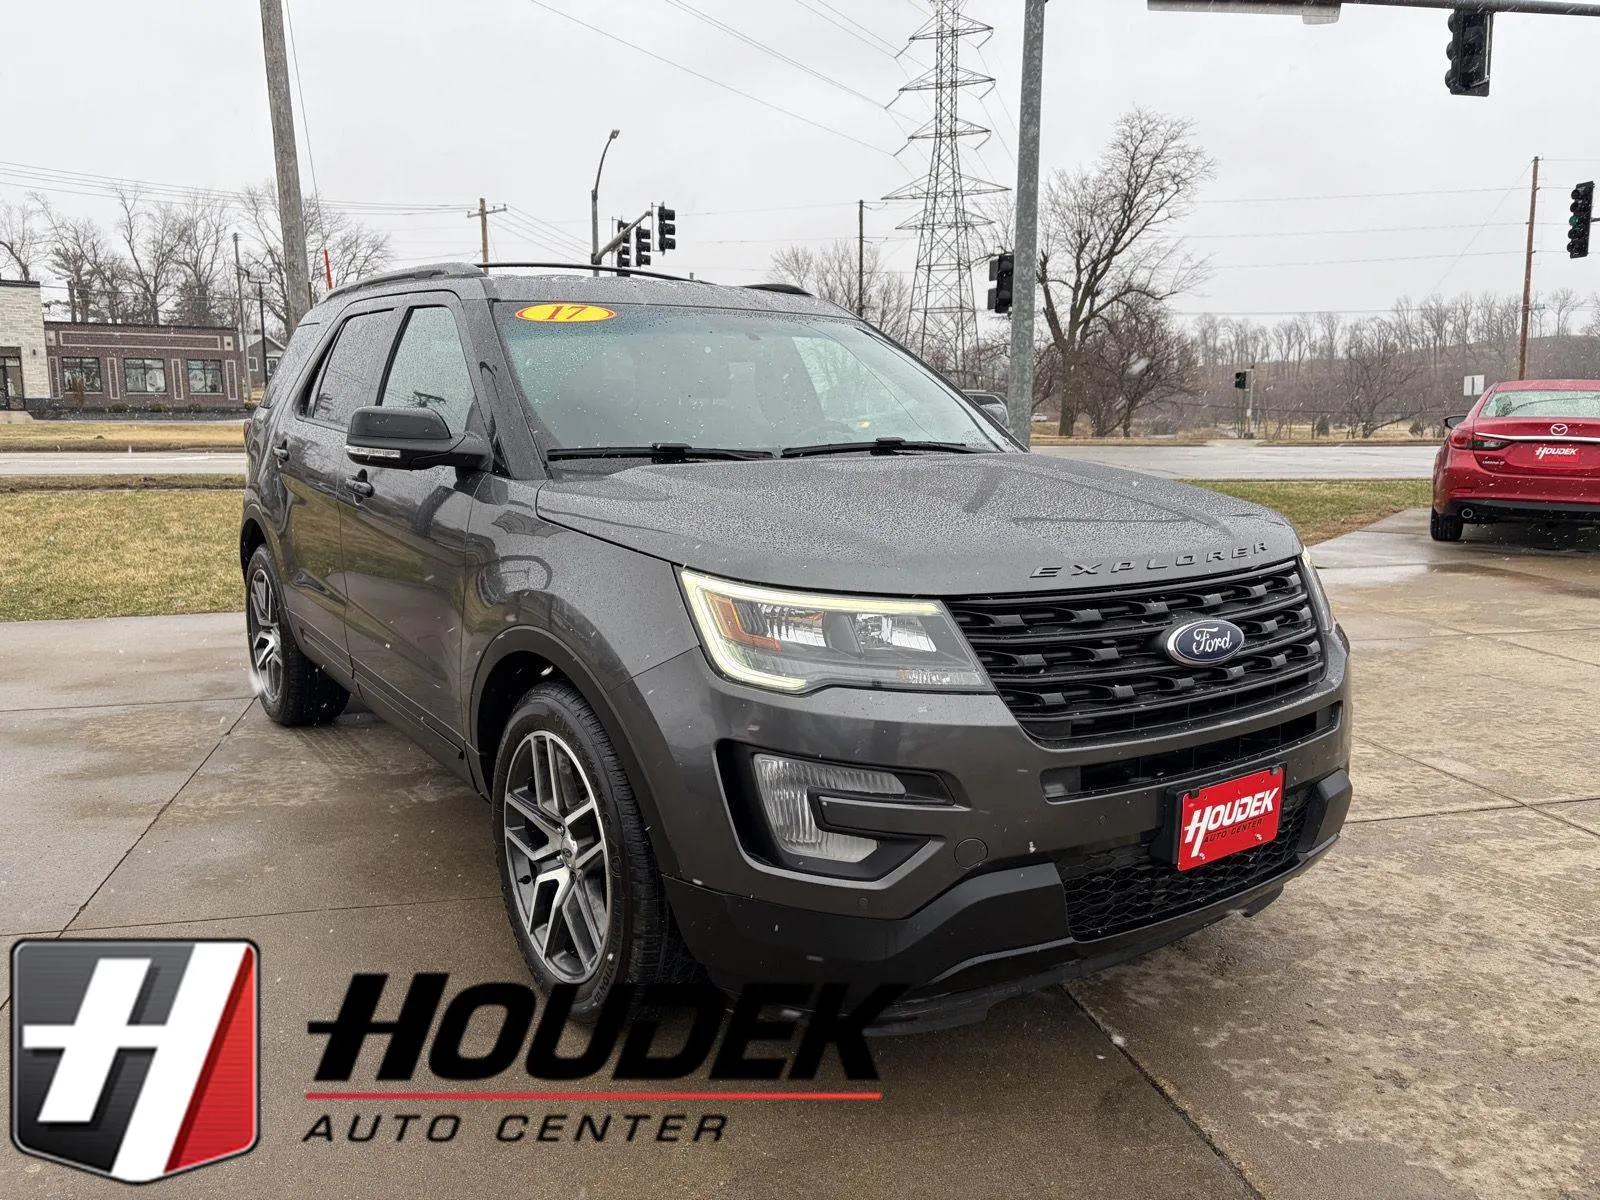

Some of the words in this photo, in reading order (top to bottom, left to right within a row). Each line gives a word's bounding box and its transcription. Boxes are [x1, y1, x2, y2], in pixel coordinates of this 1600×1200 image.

[546, 305, 588, 320] 17
[1535, 446, 1579, 460] HOUDEK
[1029, 541, 1268, 578] EXPLORER
[1193, 627, 1232, 655] Ford
[1184, 787, 1279, 858] HOUDEK
[1205, 832, 1227, 842] AUTO
[1231, 819, 1262, 835] CENTER
